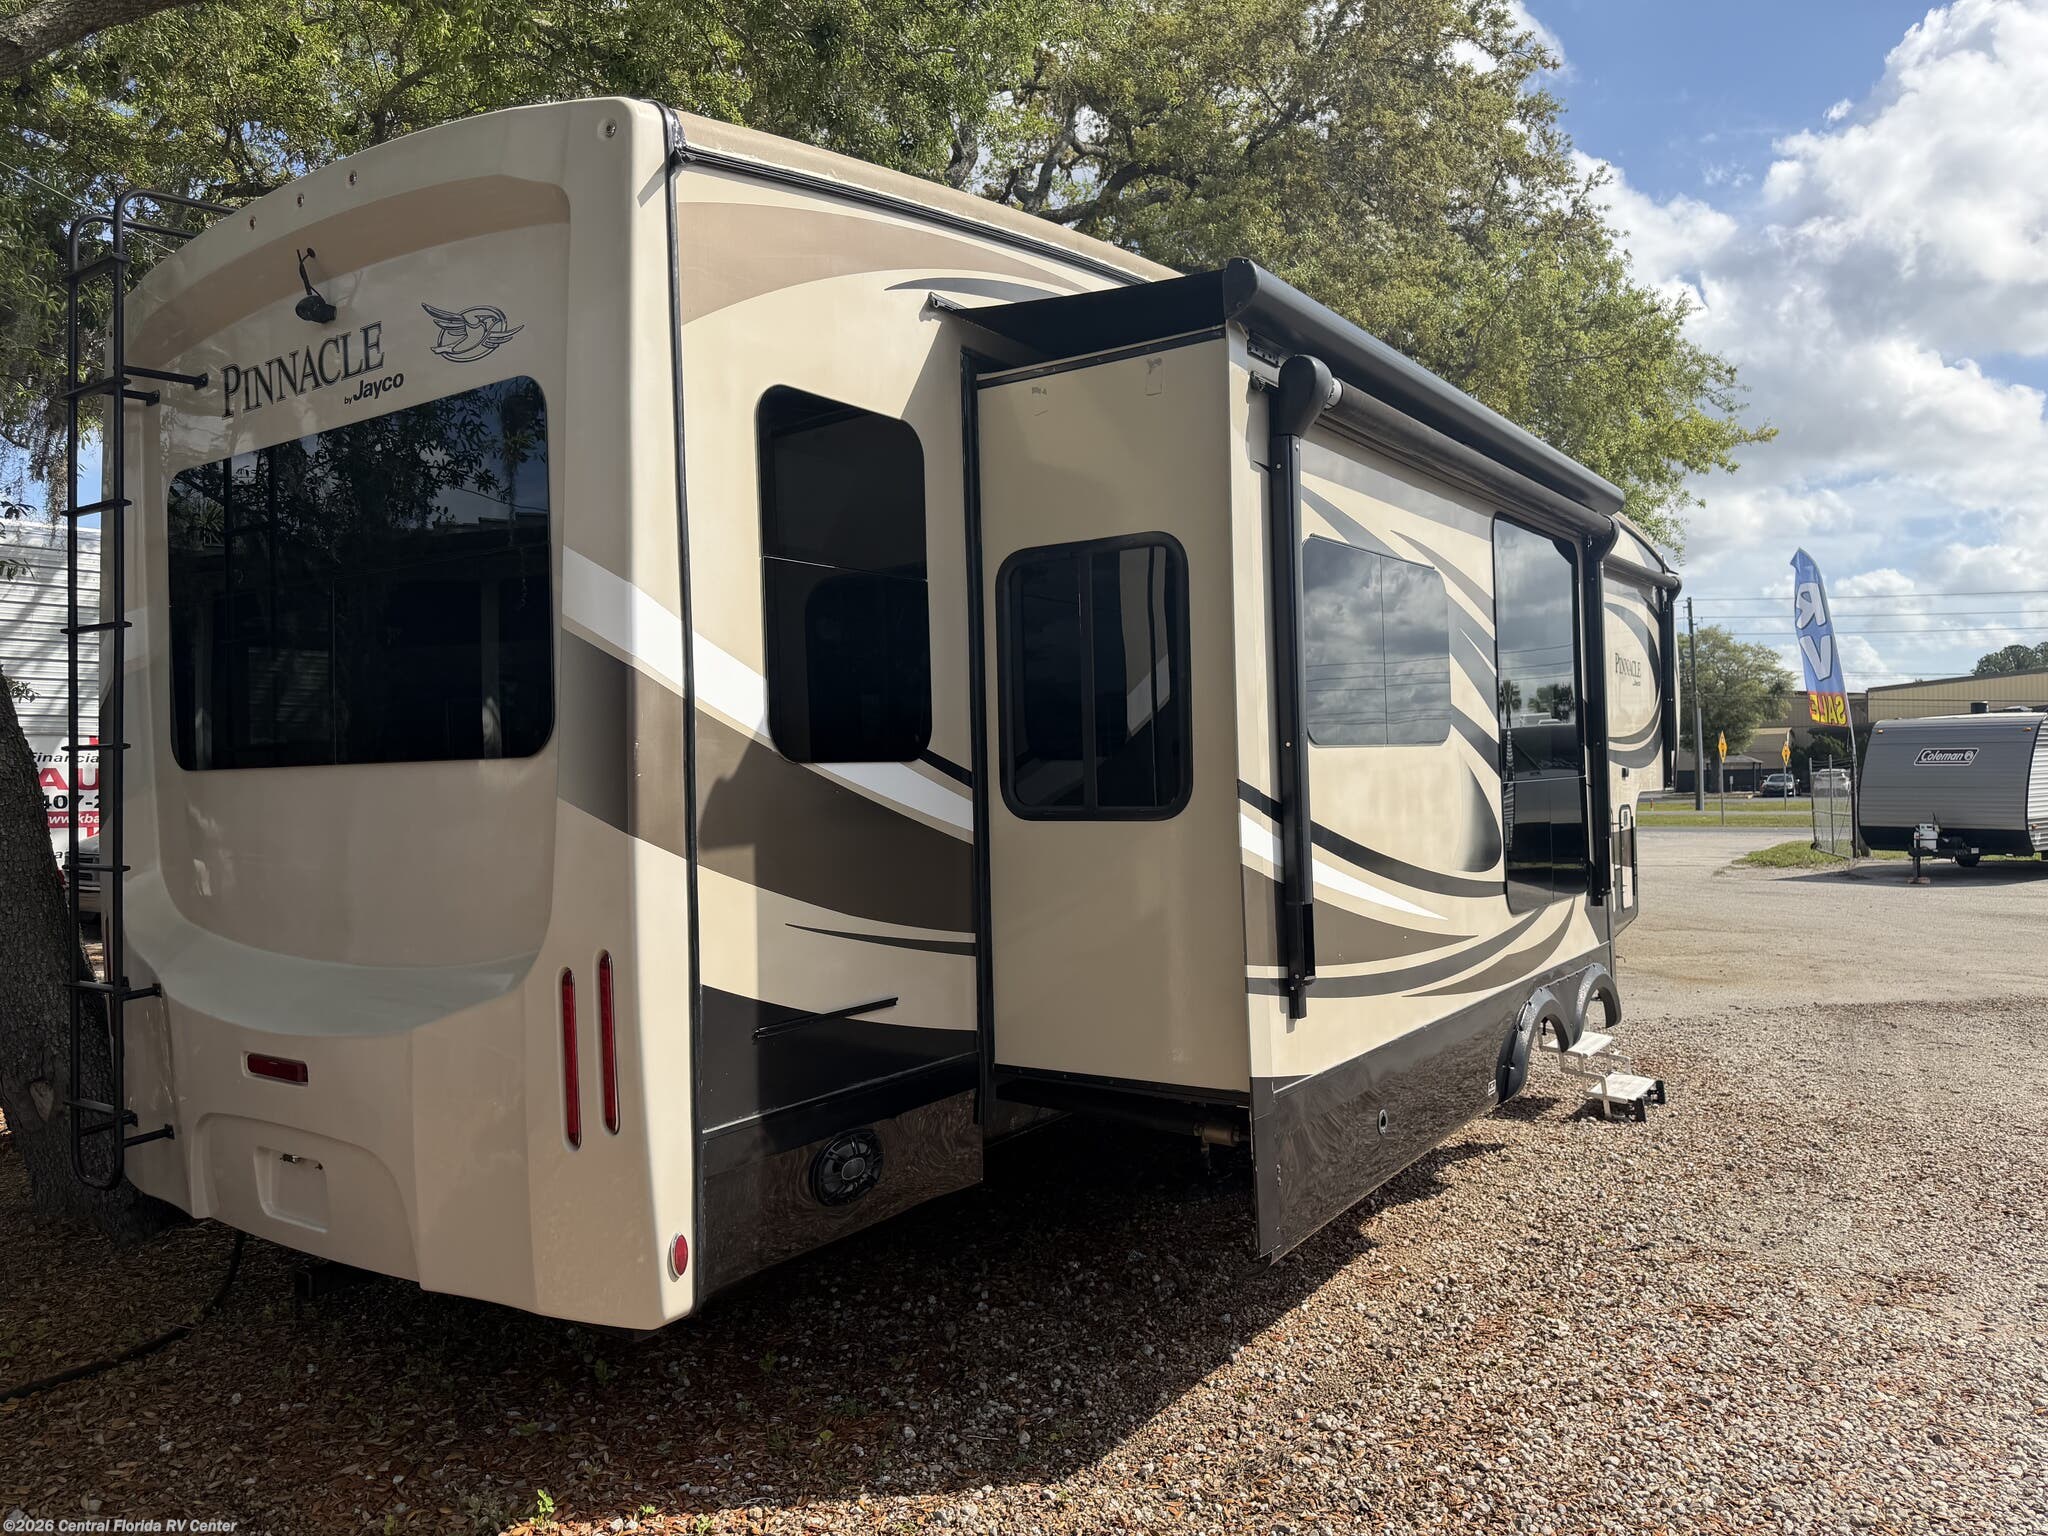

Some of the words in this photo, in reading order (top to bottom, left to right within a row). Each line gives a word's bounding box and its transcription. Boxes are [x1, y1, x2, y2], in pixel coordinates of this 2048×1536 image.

[221, 320, 385, 420] PINNACLE
[344, 396, 352, 405] by
[353, 373, 404, 402] Jayco
[1921, 750, 1964, 761] Coleman
